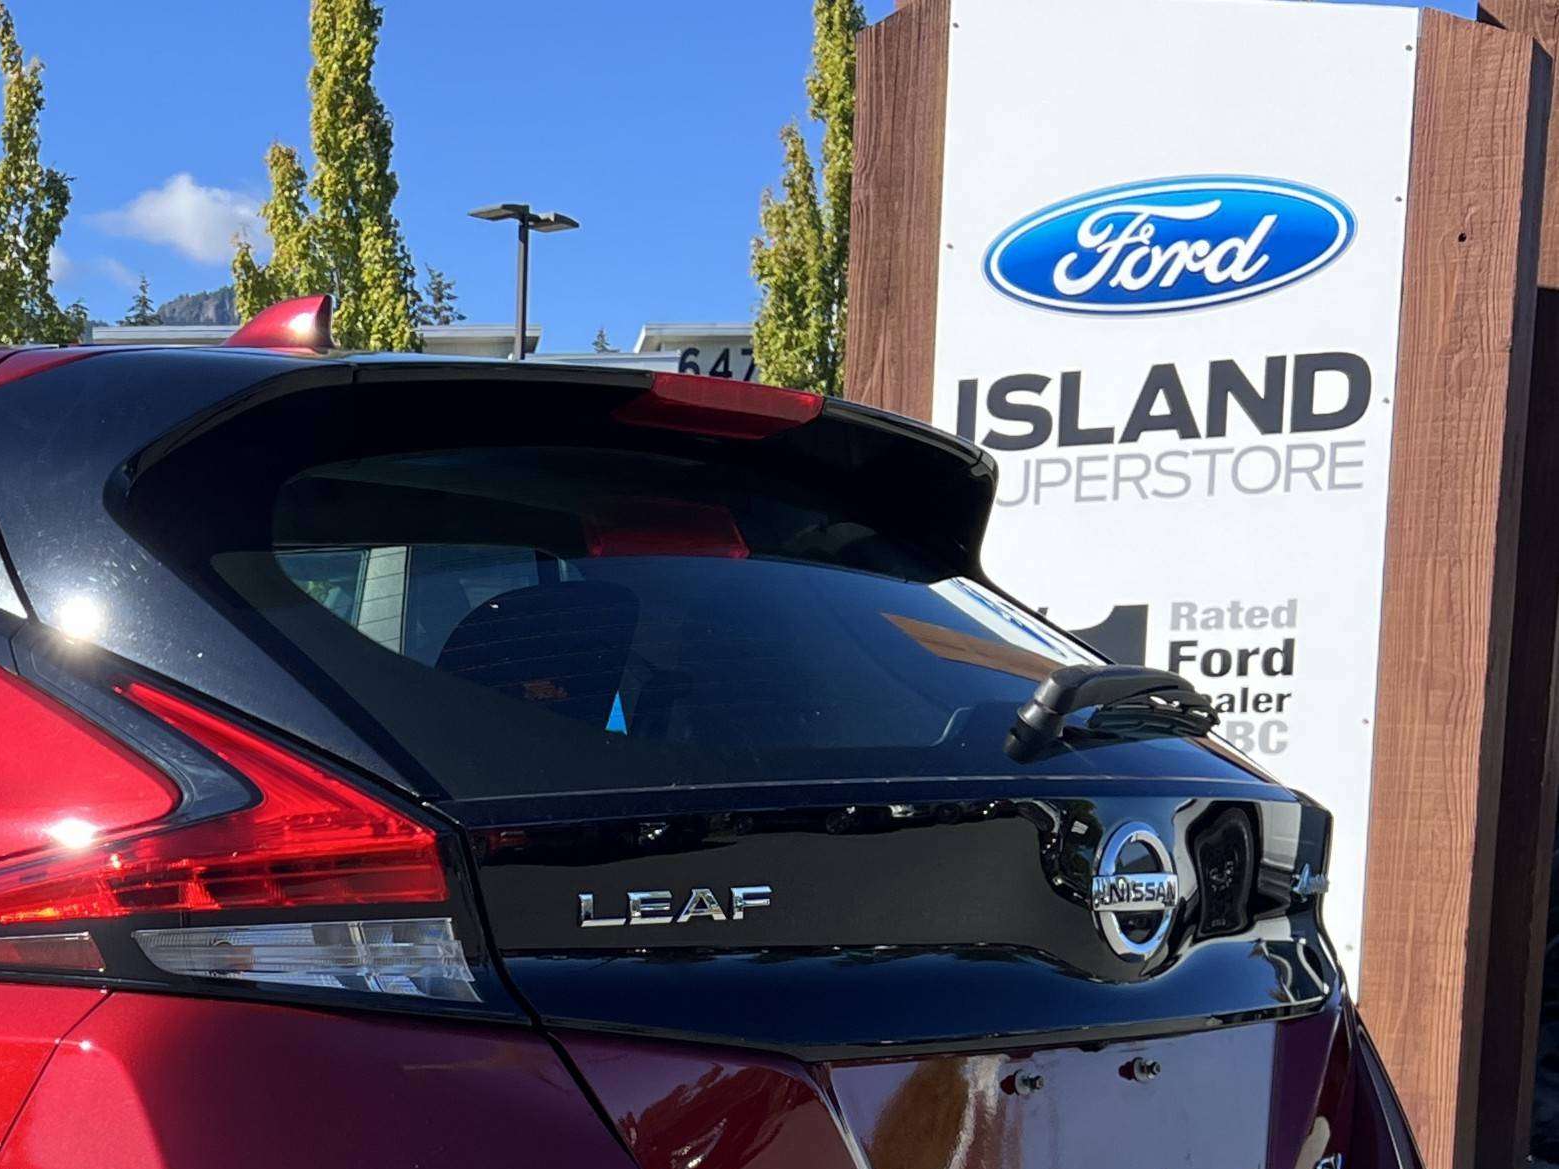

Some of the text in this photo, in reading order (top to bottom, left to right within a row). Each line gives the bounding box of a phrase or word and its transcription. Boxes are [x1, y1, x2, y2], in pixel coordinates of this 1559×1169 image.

[1053, 199, 1279, 296] Ford
[955, 351, 1372, 452] ISLAND
[996, 440, 1366, 508] UPERSTORE
[1169, 599, 1298, 632] Rated
[1168, 638, 1296, 677] Ford
[1204, 687, 1292, 713] aler
[1225, 720, 1289, 755] BC
[578, 885, 772, 928] LEAF
[1109, 880, 1177, 907] NISSAN
